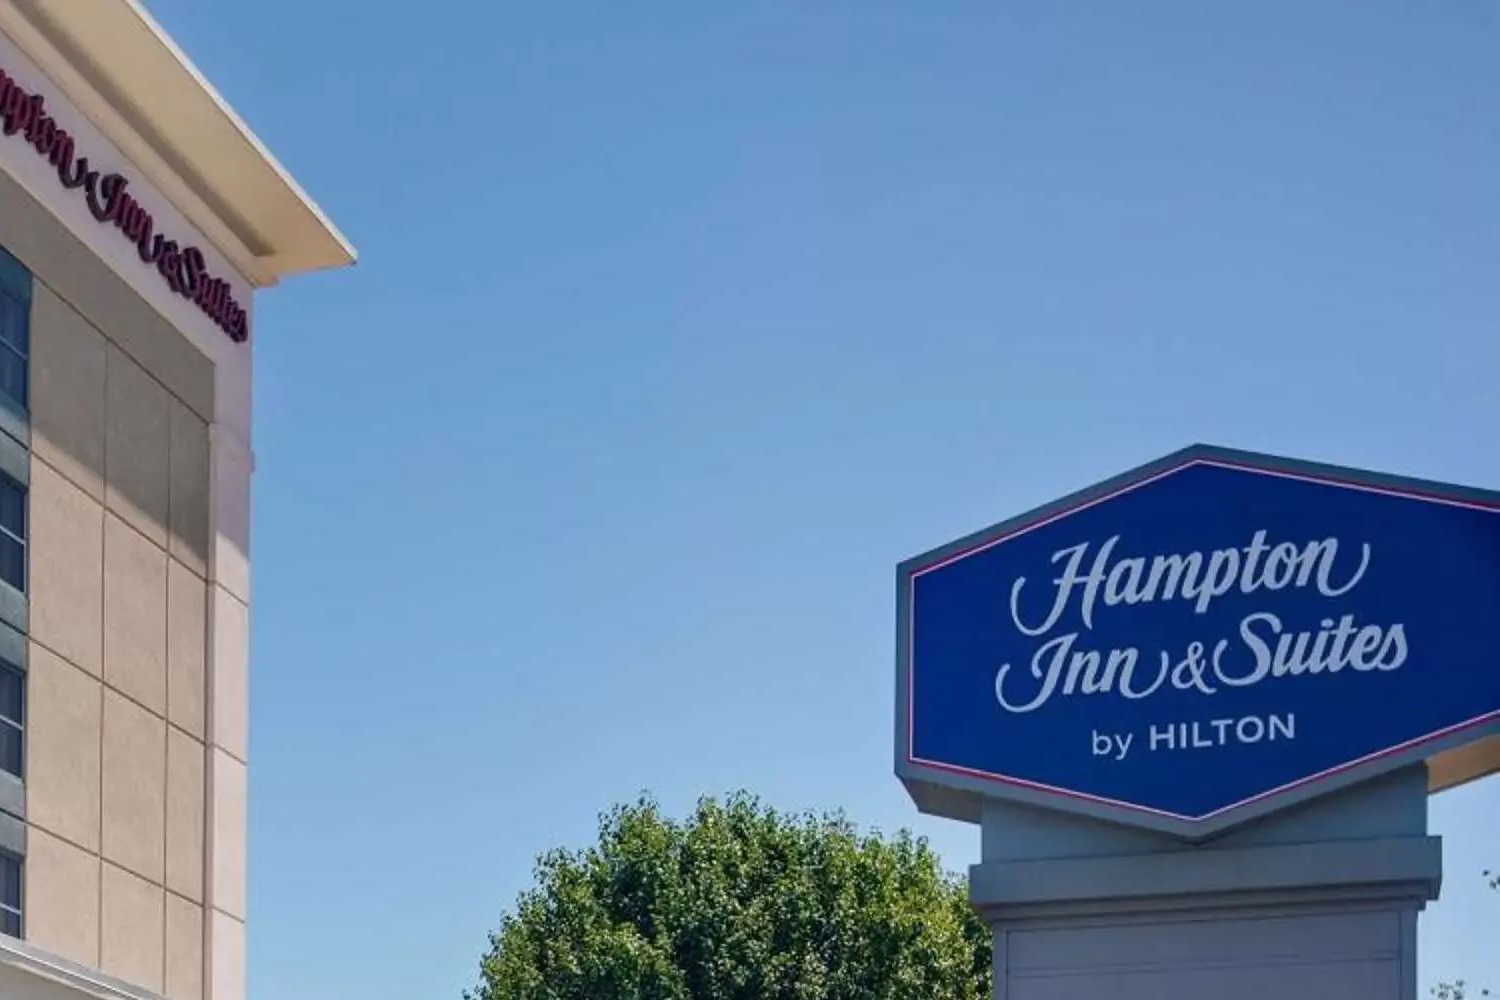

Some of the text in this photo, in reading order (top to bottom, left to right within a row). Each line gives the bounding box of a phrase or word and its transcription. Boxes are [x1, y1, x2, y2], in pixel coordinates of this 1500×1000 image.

[85, 171, 164, 263] Inn
[176, 246, 248, 343] Suites
[1009, 529, 1371, 637] Hampton
[995, 612, 1409, 713] Inn & Suites
[1091, 713, 1296, 761] by HILTON
